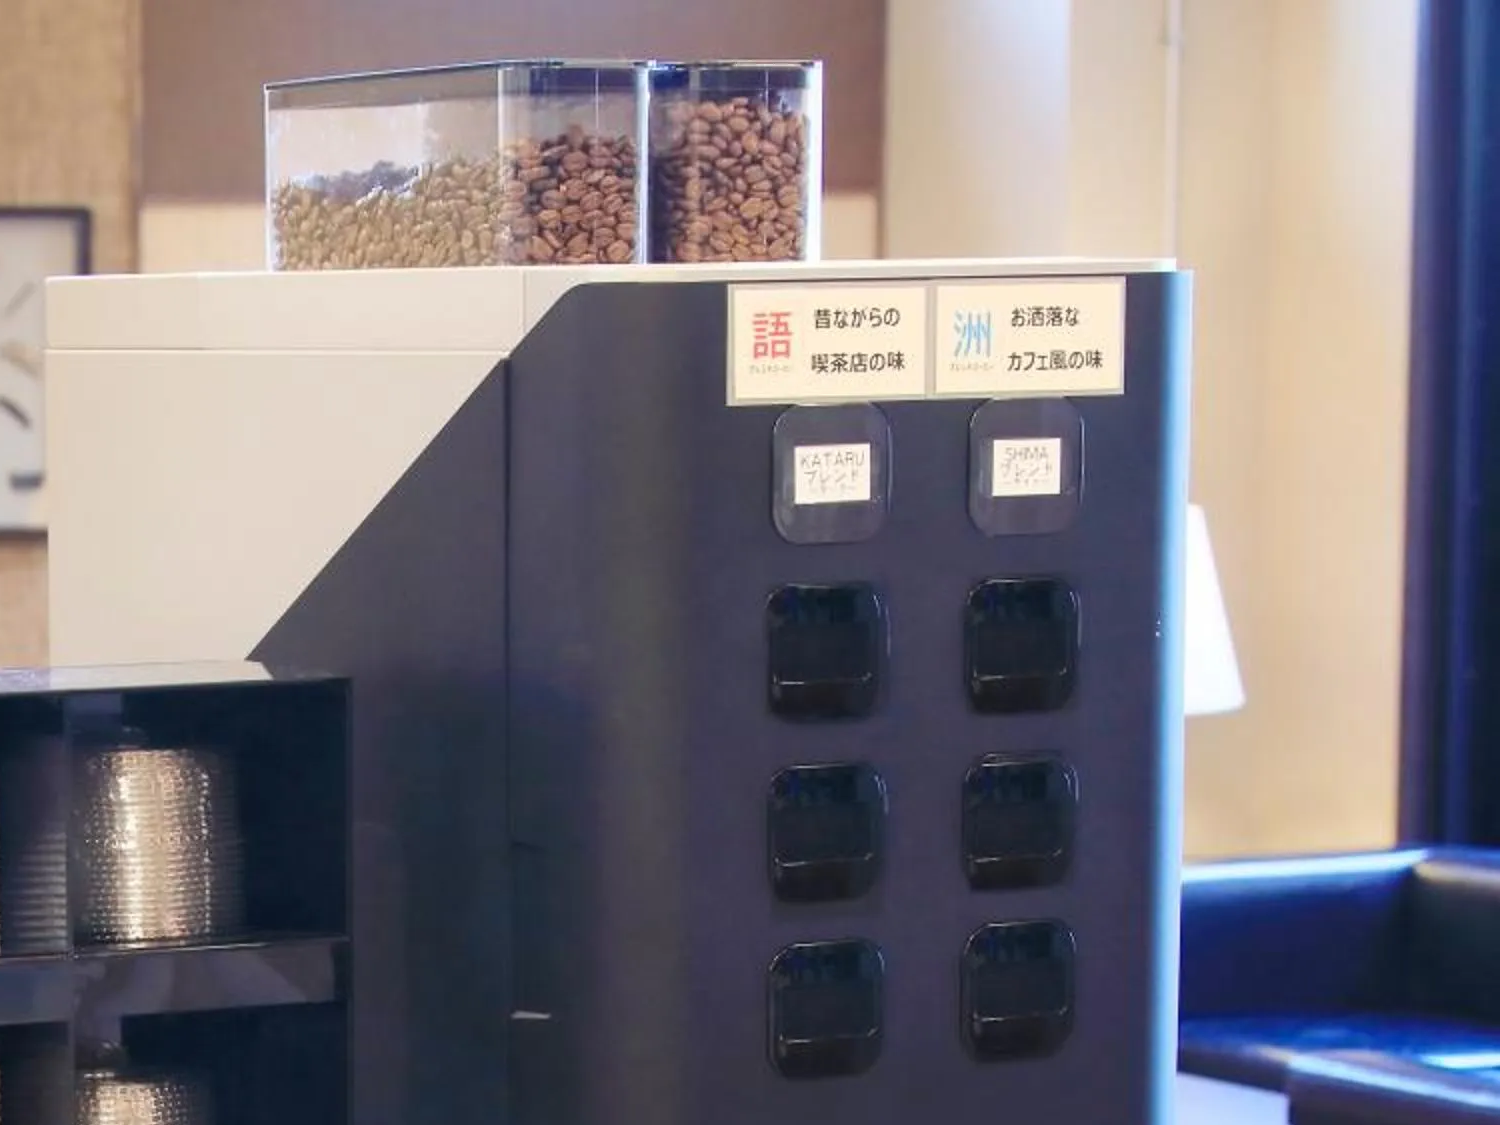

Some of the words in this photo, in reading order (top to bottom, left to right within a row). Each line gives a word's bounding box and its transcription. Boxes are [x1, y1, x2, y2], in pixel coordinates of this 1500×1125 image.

[814, 307, 900, 329] 昔ながらの
[1011, 306, 1080, 327] お洒落な
[753, 311, 793, 359] 語
[954, 306, 992, 357] 洲
[811, 351, 906, 374] 喫茶店の味
[1007, 348, 1104, 372] カフェ風の味
